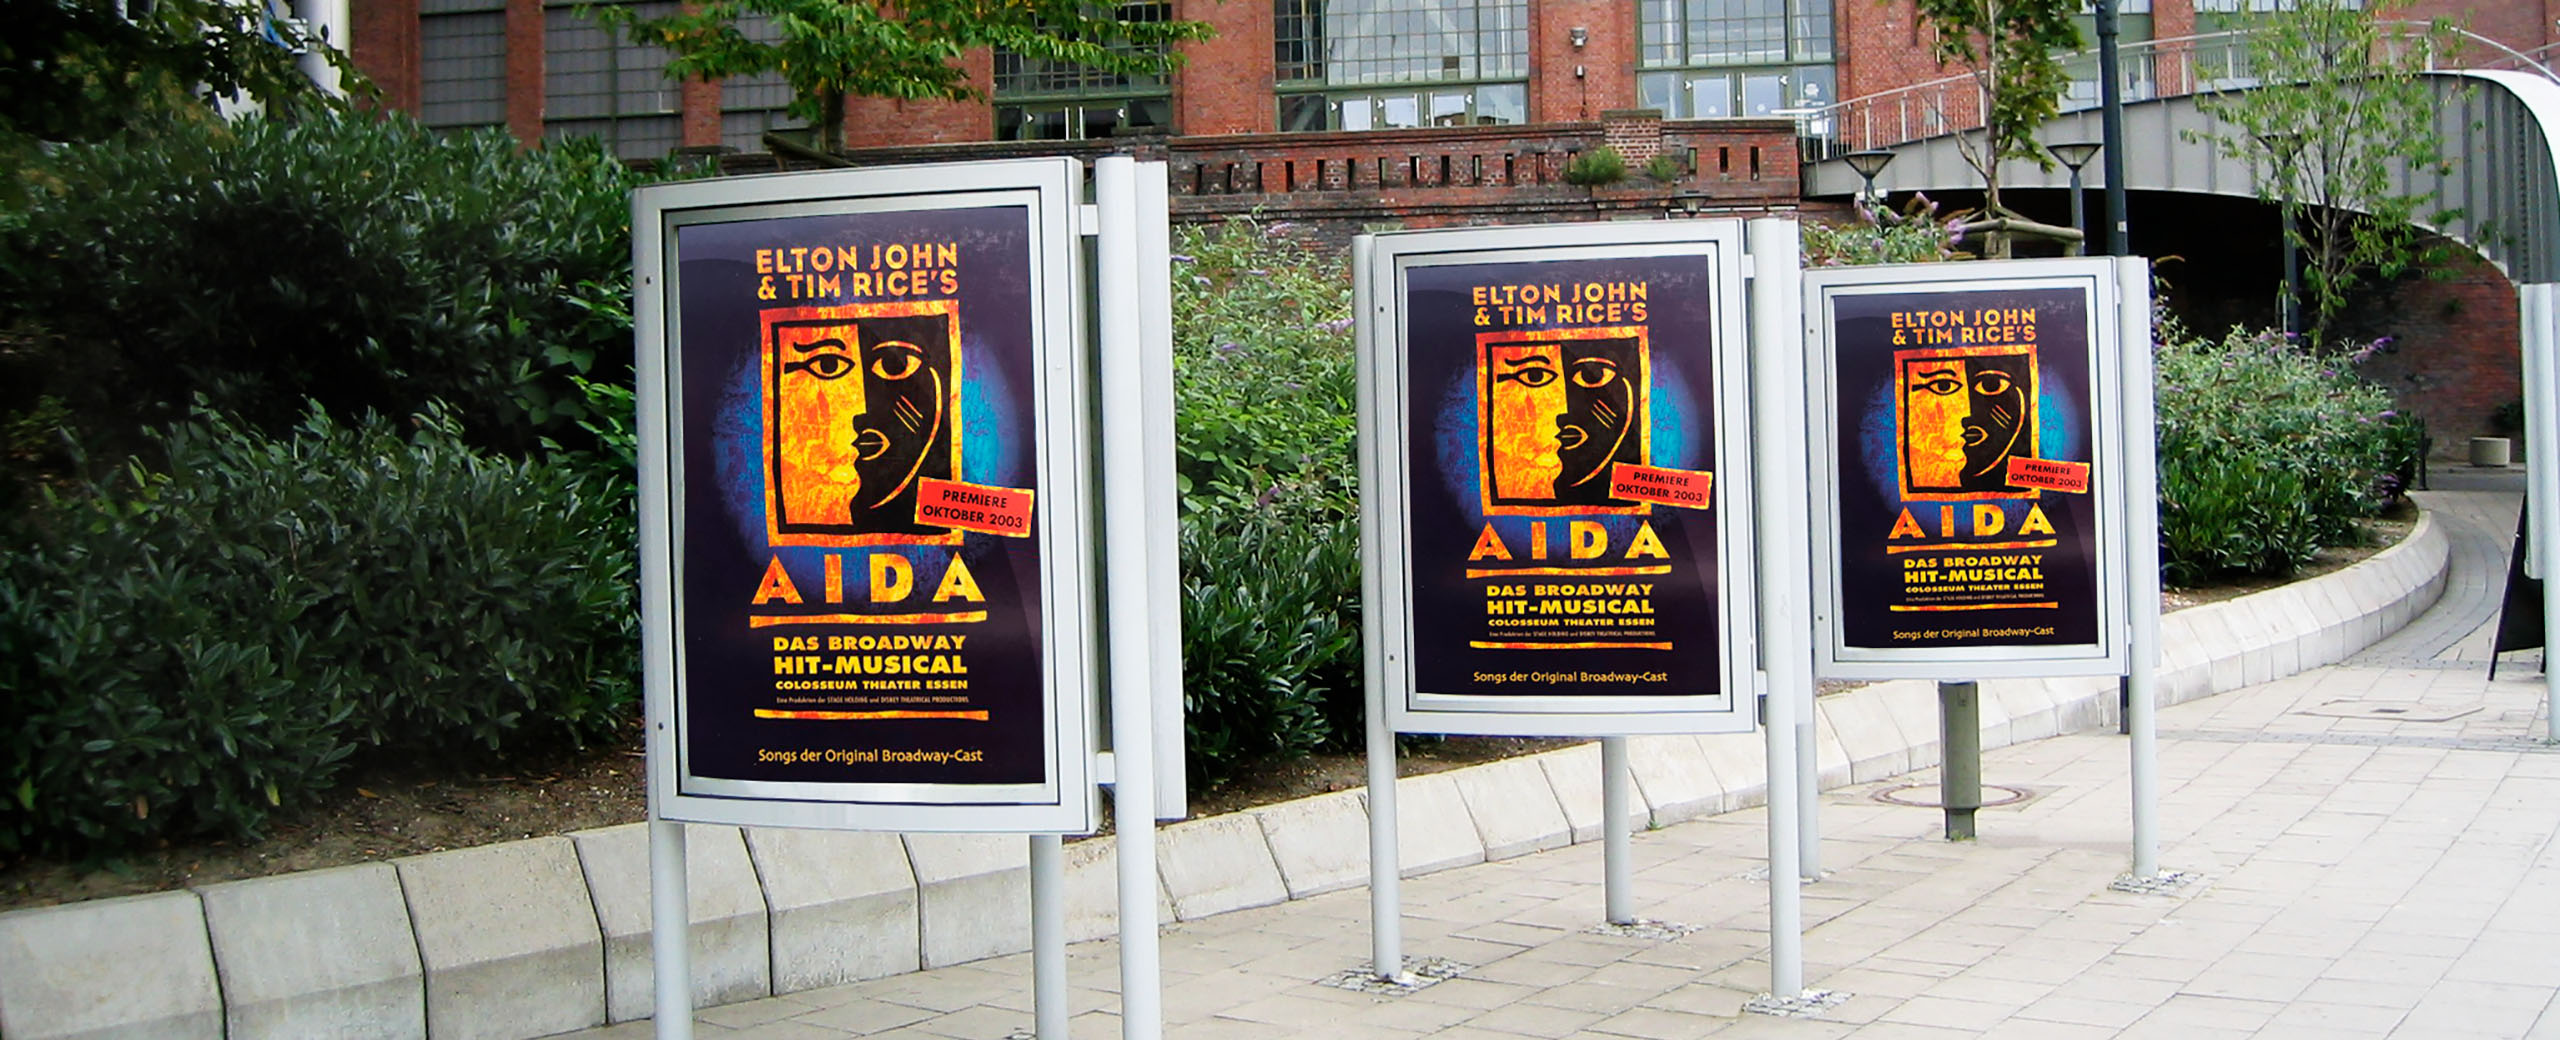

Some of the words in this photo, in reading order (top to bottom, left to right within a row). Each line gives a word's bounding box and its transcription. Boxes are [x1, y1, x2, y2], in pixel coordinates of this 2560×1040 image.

[756, 246, 857, 273] ELTON
[870, 242, 957, 269] JOHN
[758, 275, 776, 299] &
[786, 272, 840, 298] TIM
[853, 268, 957, 296] RICE'S
[1472, 284, 1559, 305] ELTON
[1571, 281, 1646, 303] JOHN
[1474, 306, 1489, 325] &
[1499, 304, 1545, 324] TIM
[1557, 302, 1647, 322] RICE'S
[1891, 310, 1963, 328] ELTON
[1973, 308, 2035, 325] JOHN
[1892, 328, 1906, 345] &
[1913, 327, 1951, 344] TIM
[1961, 325, 2035, 342] RICE'S
[2025, 464, 2070, 474] PREMIERE
[1633, 471, 1688, 486] PREMIERE
[2011, 472, 2054, 484] OKTOBER
[2058, 478, 2081, 487] 2003
[942, 489, 1006, 507] PREMIERE
[1616, 482, 1669, 497] OKTOBER
[1673, 488, 1702, 501] 2003
[923, 504, 984, 522] OKTOBER
[989, 512, 1022, 527] 2003
[1888, 502, 2055, 538] AIDA
[1468, 520, 1669, 560] AIDA
[1904, 557, 1936, 568] DAS
[1943, 554, 2041, 566] BROADWAY
[751, 551, 985, 604] AIDA
[1904, 567, 2042, 582] HIT-MUSICAL
[1487, 584, 1525, 596] DAS
[1534, 583, 1653, 595] BROADWAY
[1905, 585, 1964, 593] COLOSSEUM
[1968, 583, 2009, 591] THEATER
[1487, 599, 1653, 614] HIT-MUSICAL
[1563, 618, 1613, 626] THEATER
[1618, 618, 1654, 626] ESSEN
[1893, 630, 1920, 640] Songs
[1923, 629, 1938, 637] der
[1941, 628, 1979, 638] Original
[1983, 626, 2054, 637] Broadway-Cast
[773, 636, 818, 651] DAS
[828, 634, 966, 650] BROADWAY
[774, 654, 966, 674] HIT-MUSICAL
[775, 680, 857, 689] COLOSSEUM
[862, 680, 920, 689] THEATER
[926, 680, 967, 688] ESSEN
[1473, 671, 1506, 683] Songs
[1510, 671, 1527, 681] der
[1531, 671, 1576, 683] Original
[1580, 671, 1667, 683] Broadway-Cast
[758, 748, 797, 763] Songs
[800, 749, 820, 762] der
[825, 748, 877, 764] Original
[882, 748, 983, 763] Broadway-Cast
